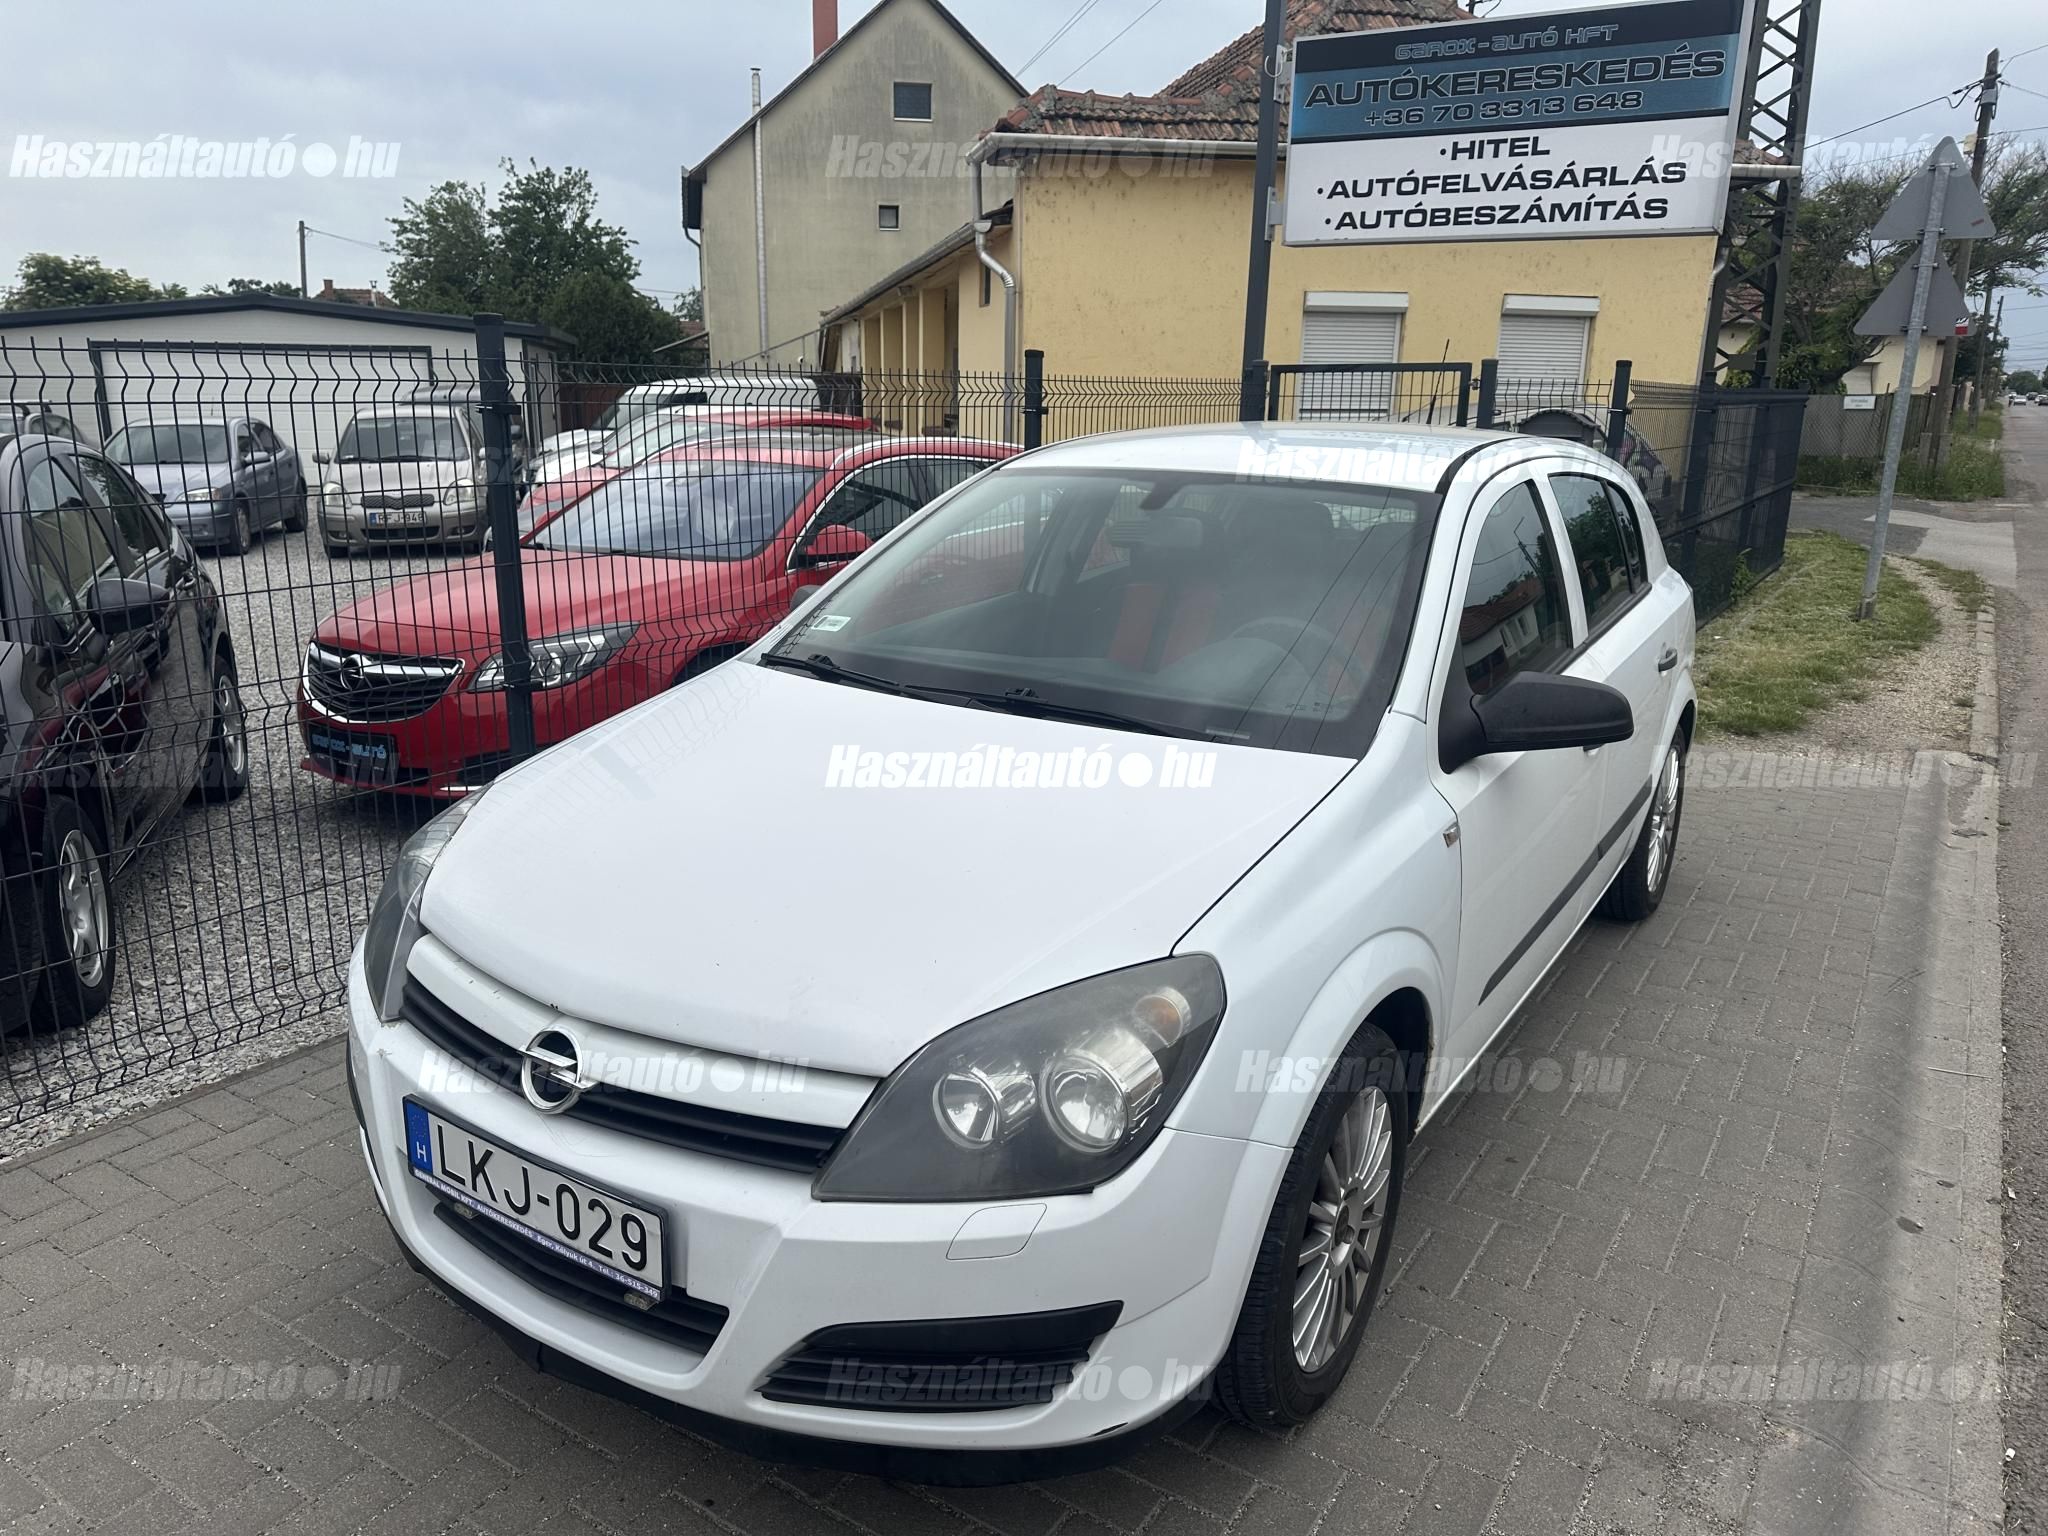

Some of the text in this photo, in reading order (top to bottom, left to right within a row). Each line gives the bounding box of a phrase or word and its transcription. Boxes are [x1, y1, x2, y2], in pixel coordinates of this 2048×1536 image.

[1304, 42, 1725, 109] AUTÓKERESKEDÉS
[1364, 90, 1644, 127] +36 70 3313 648
[1327, 156, 1687, 199] AUTÓFELVÁSÁRLÁS
[1335, 191, 1668, 231] AUTÓBESZÁMÍTÁS
[416, 1141, 427, 1162] H
[414, 1169, 440, 1188] GENERAL
[440, 1184, 461, 1200] MOBIL
[476, 1204, 533, 1238] AUTÓKERESKEDÉS
[437, 1124, 647, 1272] LKJ-029
